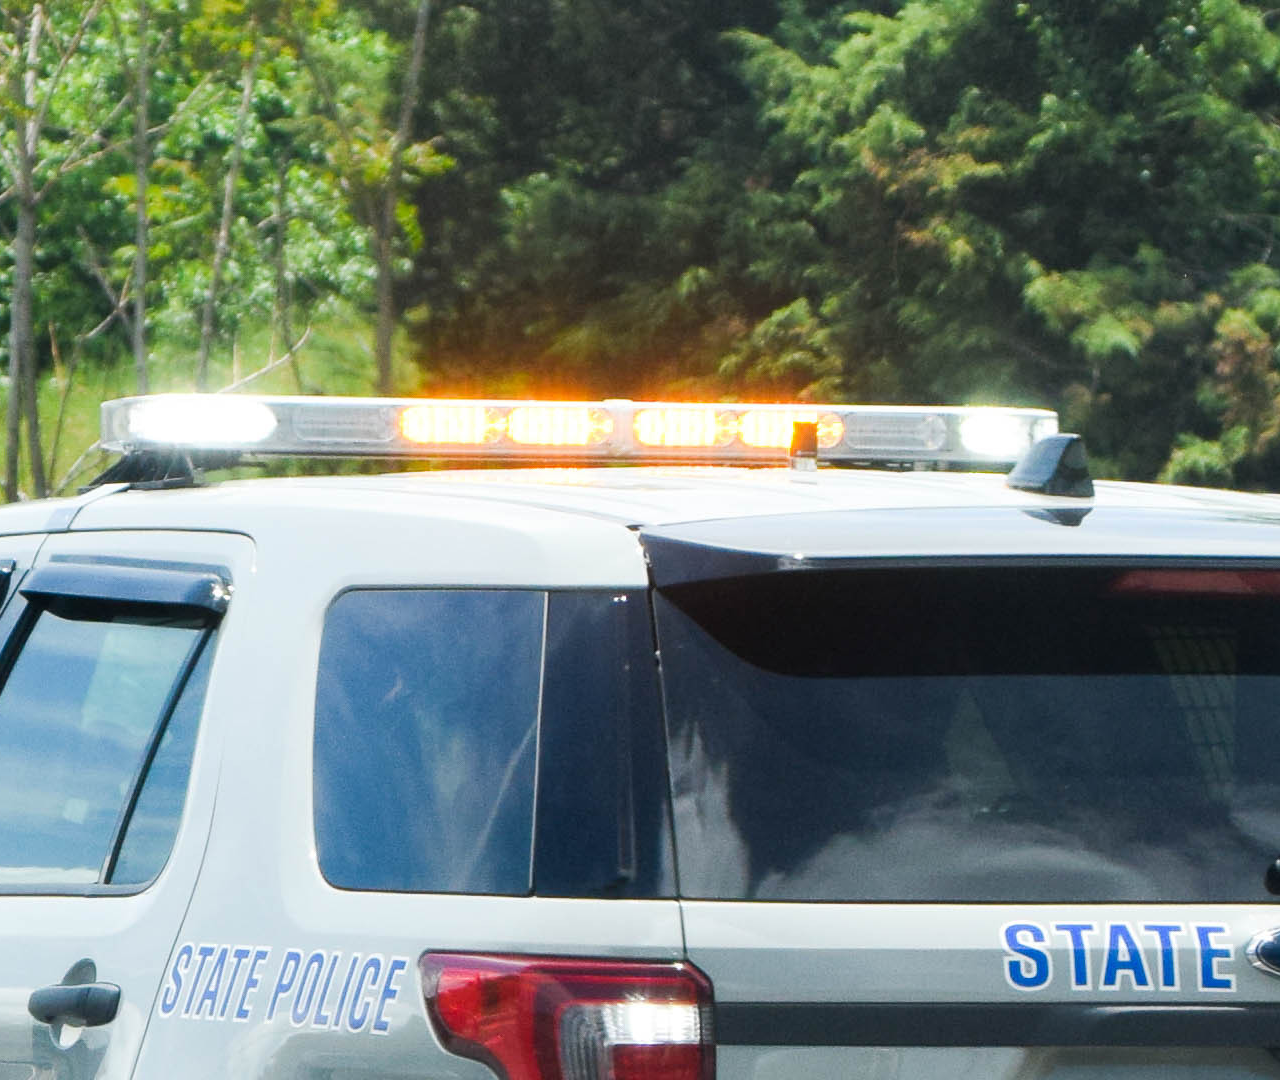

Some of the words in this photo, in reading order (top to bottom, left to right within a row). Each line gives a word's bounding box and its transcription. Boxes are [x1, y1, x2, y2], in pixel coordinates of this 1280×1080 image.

[159, 943, 271, 1022] STATE
[264, 949, 409, 1035] POLICE
[1001, 920, 1236, 992] STATE
